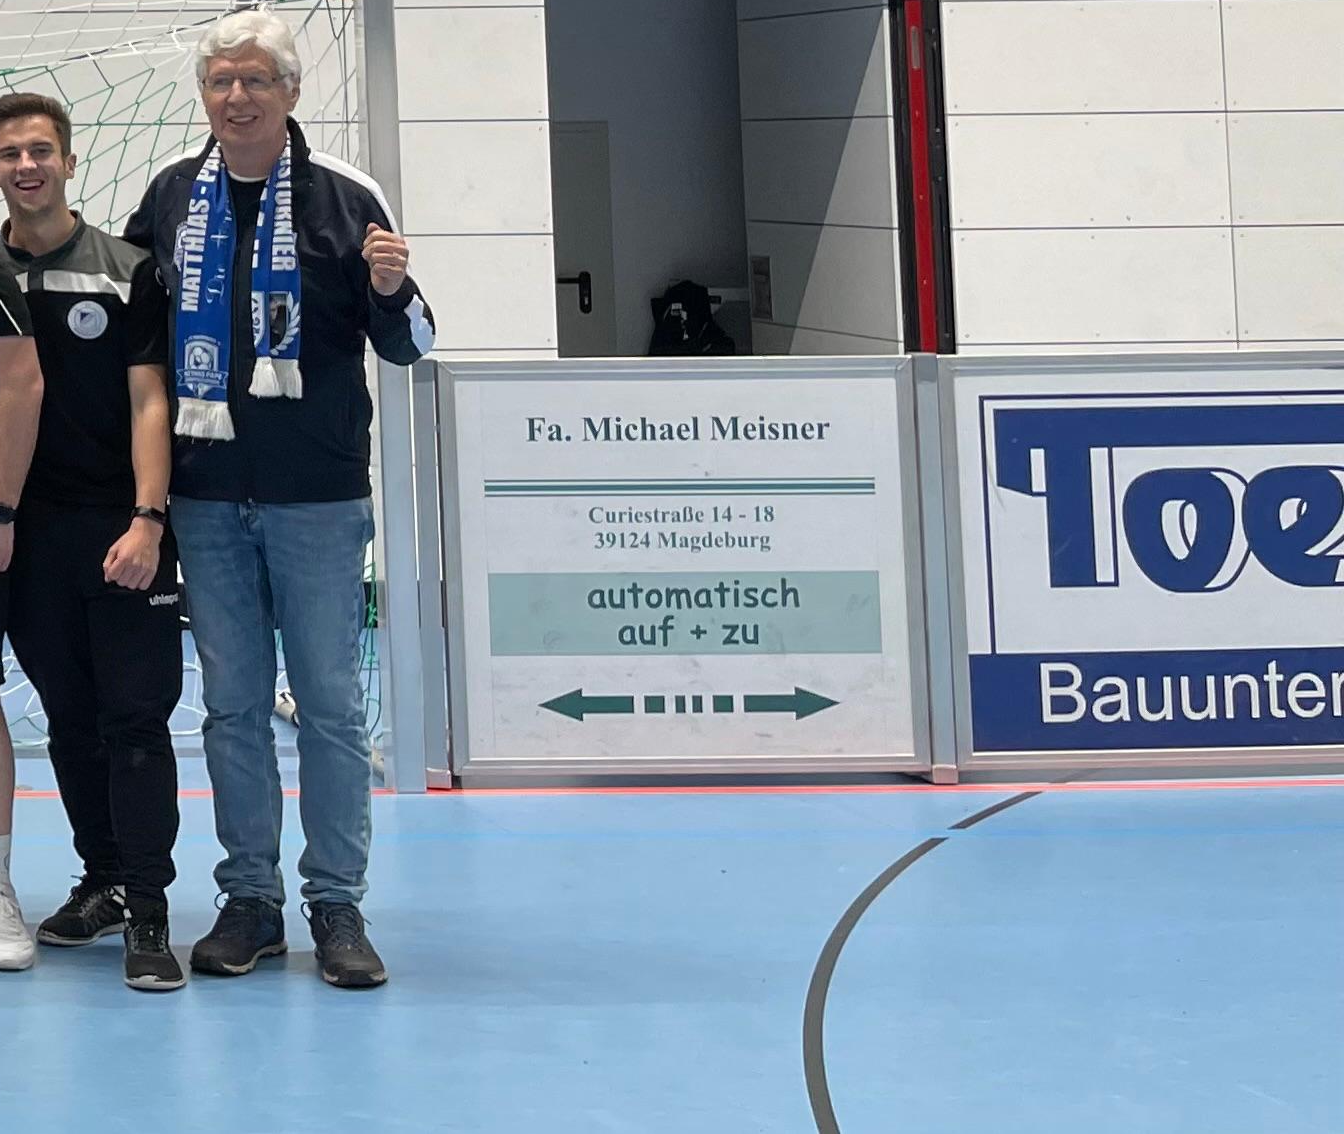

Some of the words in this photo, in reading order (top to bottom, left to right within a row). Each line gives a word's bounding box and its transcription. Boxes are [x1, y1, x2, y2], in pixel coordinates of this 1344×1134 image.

[180, 198, 210, 312] MATTHIAS
[526, 417, 572, 444] Fa.
[582, 415, 700, 442] Michael
[710, 415, 830, 442] Meisner
[588, 505, 705, 525] Curiestraße
[711, 505, 733, 523] 14
[753, 505, 775, 523] 18
[594, 531, 651, 550] 39124
[657, 531, 771, 553] Magdeburg
[587, 577, 800, 609] automatisch
[618, 616, 675, 647] auf
[690, 624, 708, 641] +
[722, 623, 760, 645] zu
